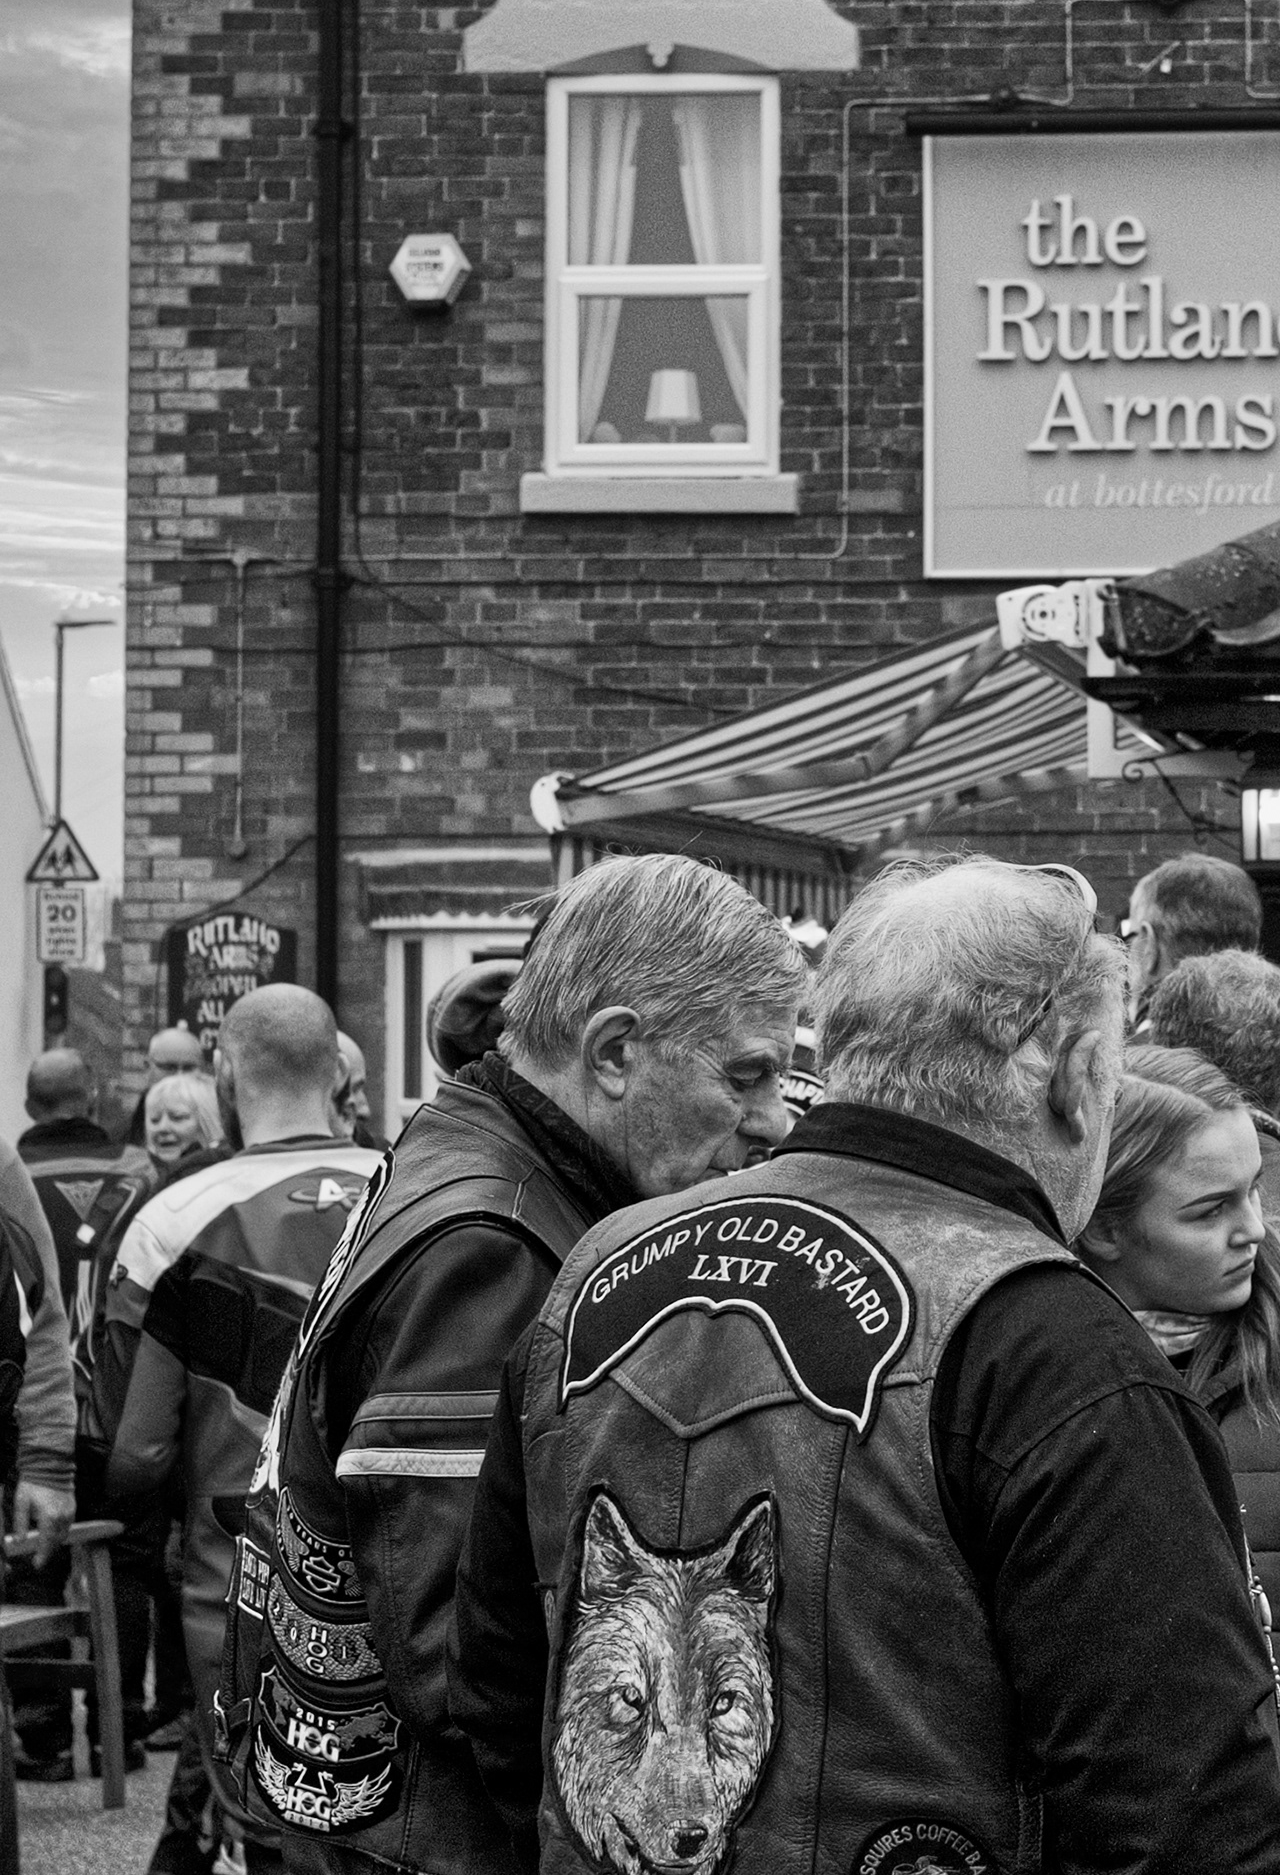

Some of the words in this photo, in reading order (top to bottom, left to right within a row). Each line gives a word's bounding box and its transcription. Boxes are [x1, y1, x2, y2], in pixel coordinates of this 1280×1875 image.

[1022, 194, 1147, 266] the
[1026, 371, 1277, 452] Arms
[1045, 481, 1079, 508] at
[1094, 473, 1275, 513] bottesford
[46, 904, 77, 923] 20
[187, 914, 281, 957] RUTLAND
[591, 1222, 712, 1304] GRUMPY
[717, 1217, 779, 1244] OLD
[778, 1225, 890, 1335] BASTARD
[688, 1255, 778, 1288] LXVI
[306, 1626, 328, 1674] HOG
[296, 1707, 336, 1731] 2015
[286, 1717, 341, 1763] HOG
[286, 1785, 332, 1820] HOG
[916, 1824, 973, 1856] COFFEE
